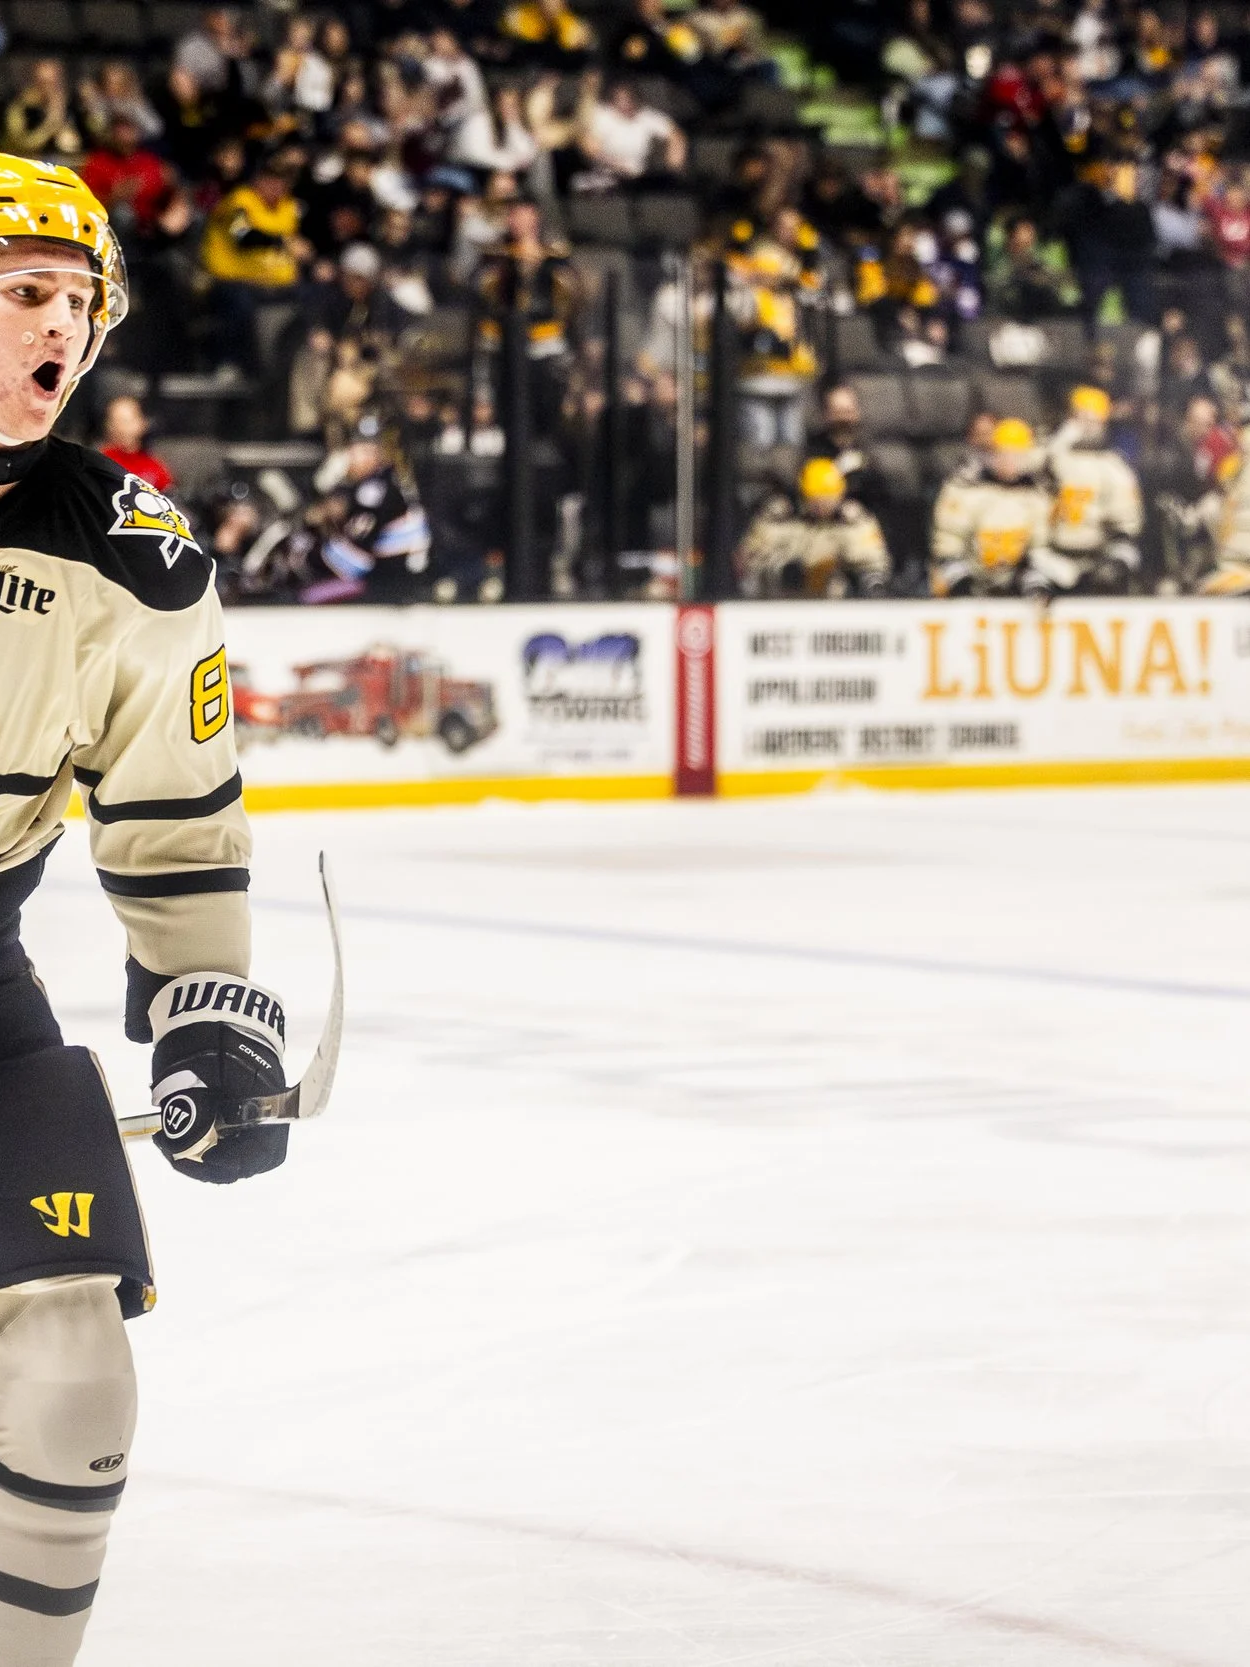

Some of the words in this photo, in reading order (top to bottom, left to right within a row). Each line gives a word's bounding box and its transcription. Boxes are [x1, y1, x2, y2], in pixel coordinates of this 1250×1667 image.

[190, 643, 230, 744] 8
[920, 616, 1212, 698] LiUNA!
[238, 1043, 272, 1070] COVERT
